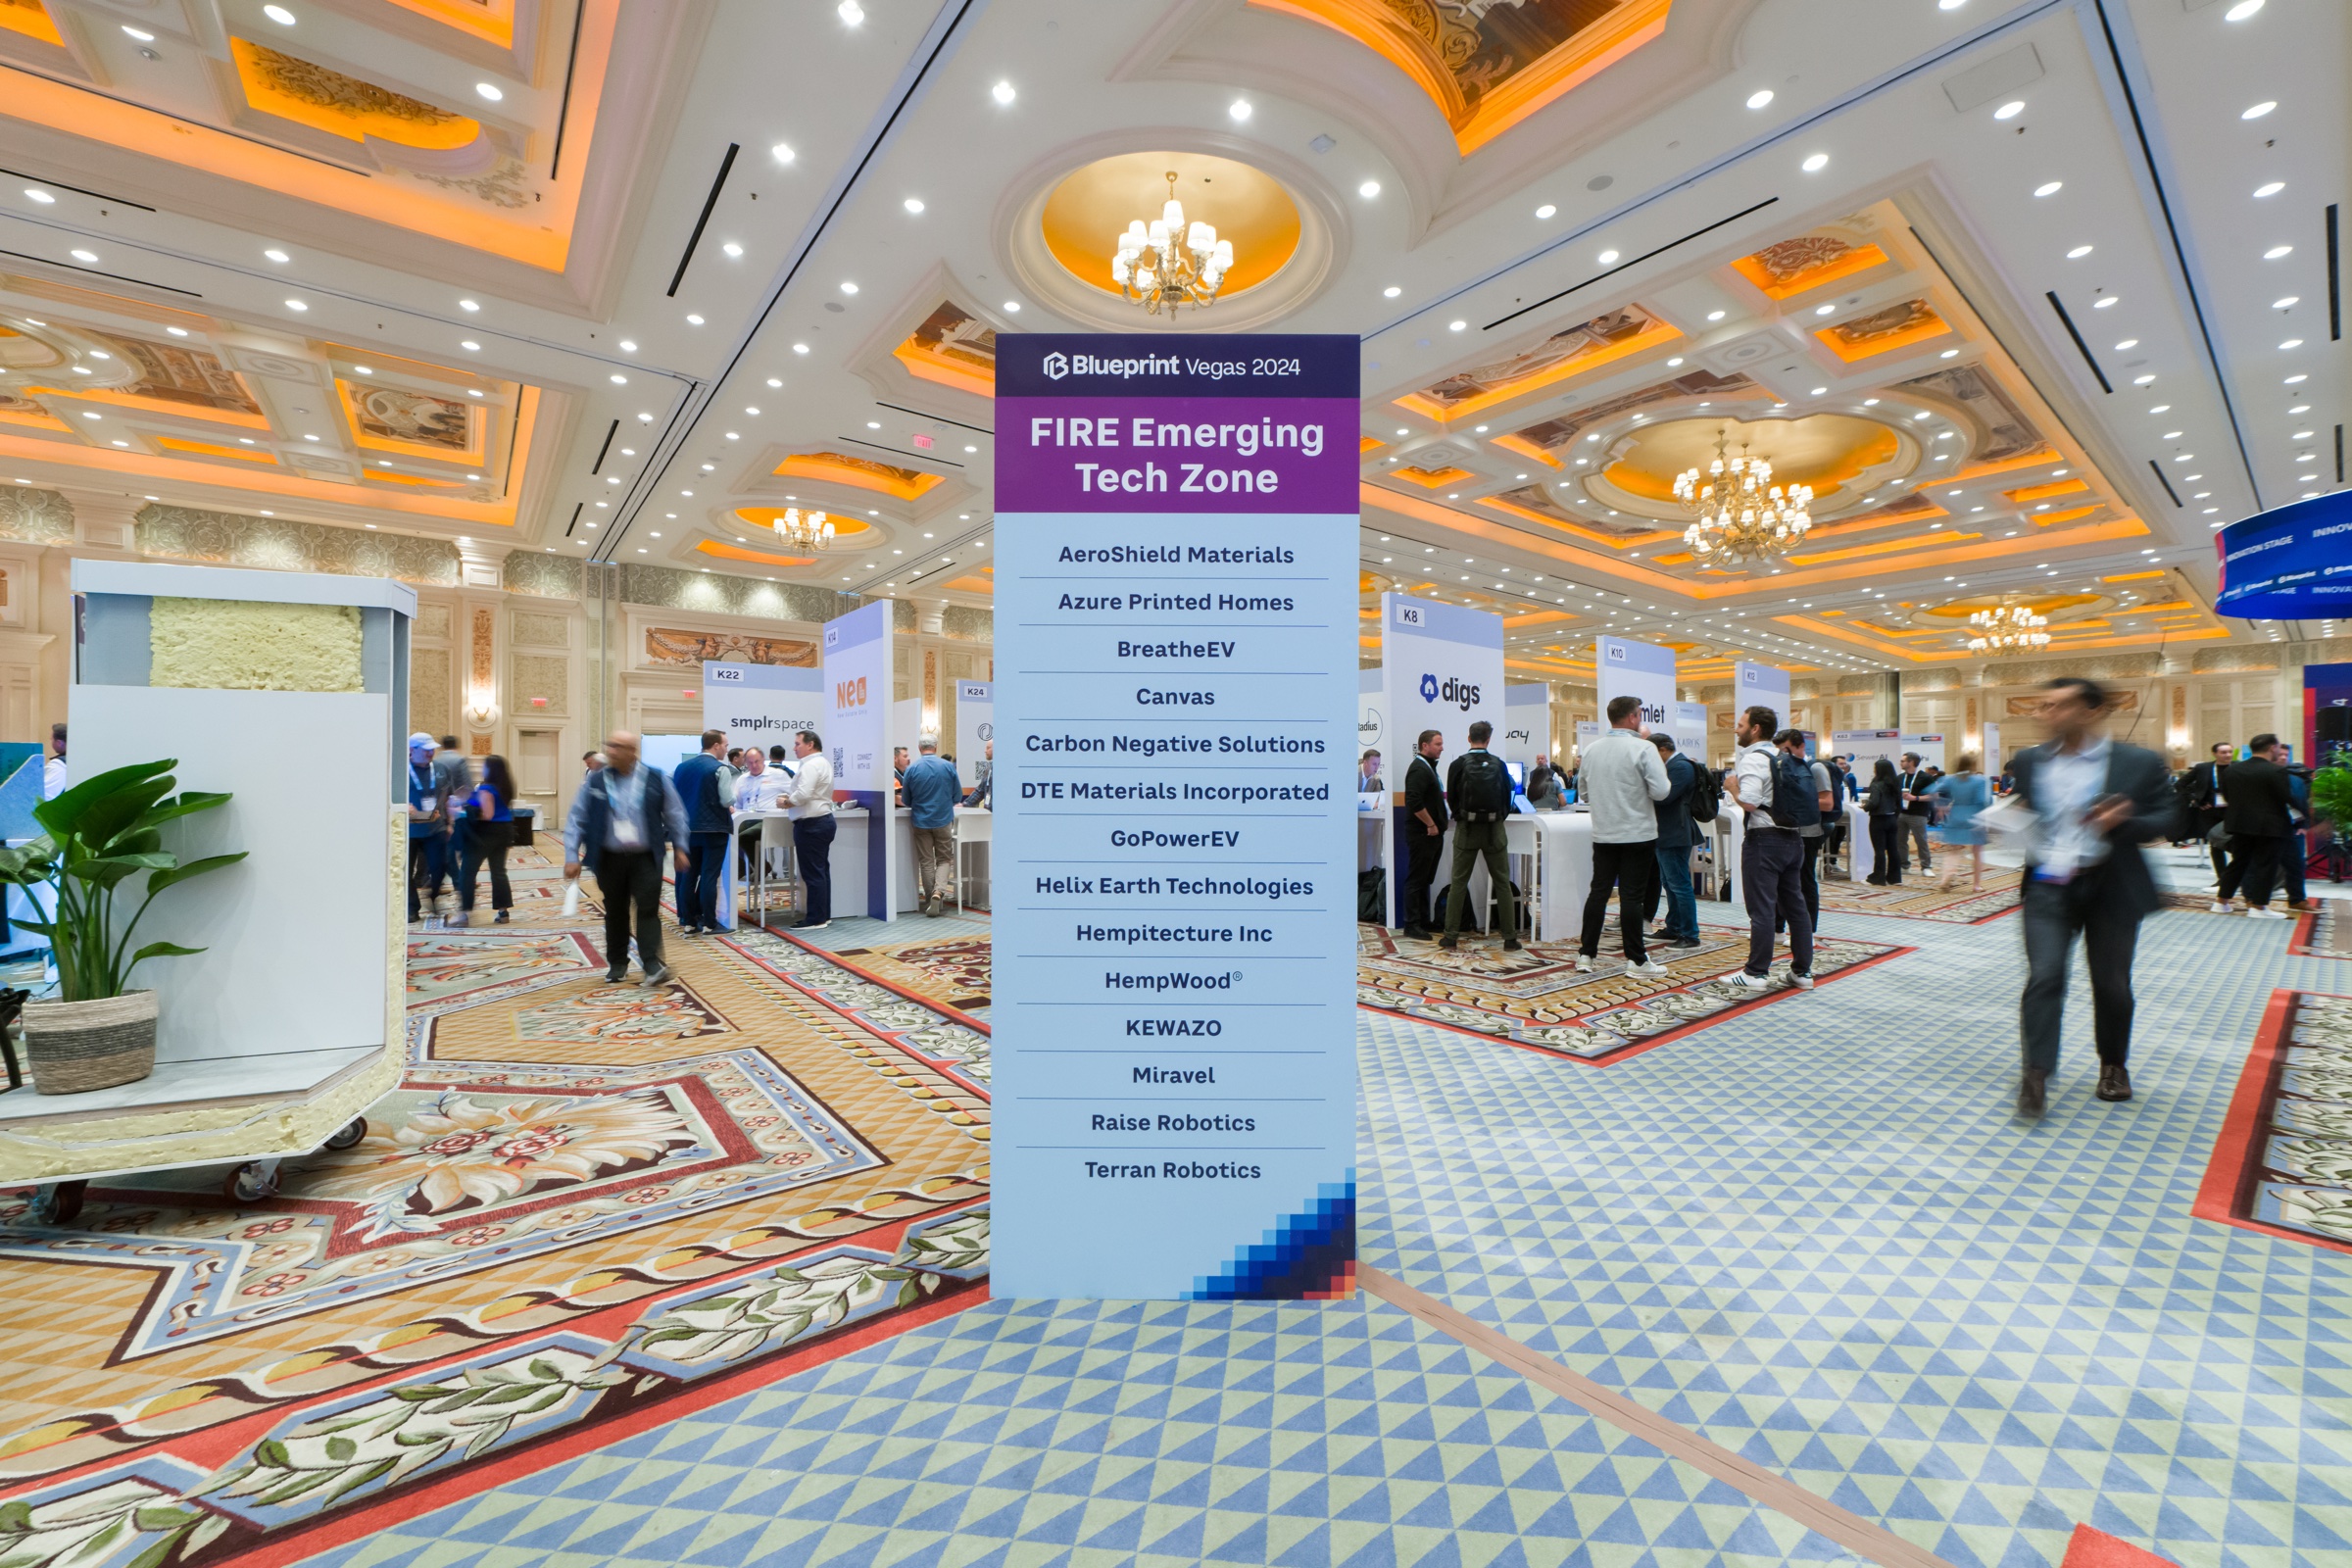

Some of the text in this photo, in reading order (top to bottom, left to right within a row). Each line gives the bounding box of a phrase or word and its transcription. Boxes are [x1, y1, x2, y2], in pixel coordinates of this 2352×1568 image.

[1072, 353, 1301, 380] Blueprint Vegas 2024
[1031, 416, 1324, 457] FIRE Emerging
[1075, 462, 1279, 493] Tech Zone
[1057, 545, 1295, 564] AeroShield Materials
[1057, 593, 1295, 612] Azure Printed Homes
[1403, 609, 1418, 623] K8
[1117, 640, 1236, 659] BreatheEV
[1611, 647, 1624, 659] K10
[717, 669, 740, 680] K22
[967, 687, 985, 696] K24
[1136, 688, 1215, 706] Canvas
[1442, 676, 1481, 711] digs
[730, 715, 814, 732] smplrspace
[1641, 704, 1665, 724] mlet
[1025, 734, 1326, 758] Carbon Negative Solutions
[1021, 782, 1330, 805] DTE Materials Incorporated
[1110, 829, 1240, 848] GoPowerEV
[1036, 876, 1314, 900] Helix Earth Technologies
[1076, 923, 1273, 946] Hempitecture Inc
[1126, 1019, 1222, 1037] KEWAZO
[1133, 1066, 1216, 1084] Miravel
[1092, 1113, 1255, 1132] Raise Robotics
[1084, 1160, 1261, 1179] Terran Robotics
